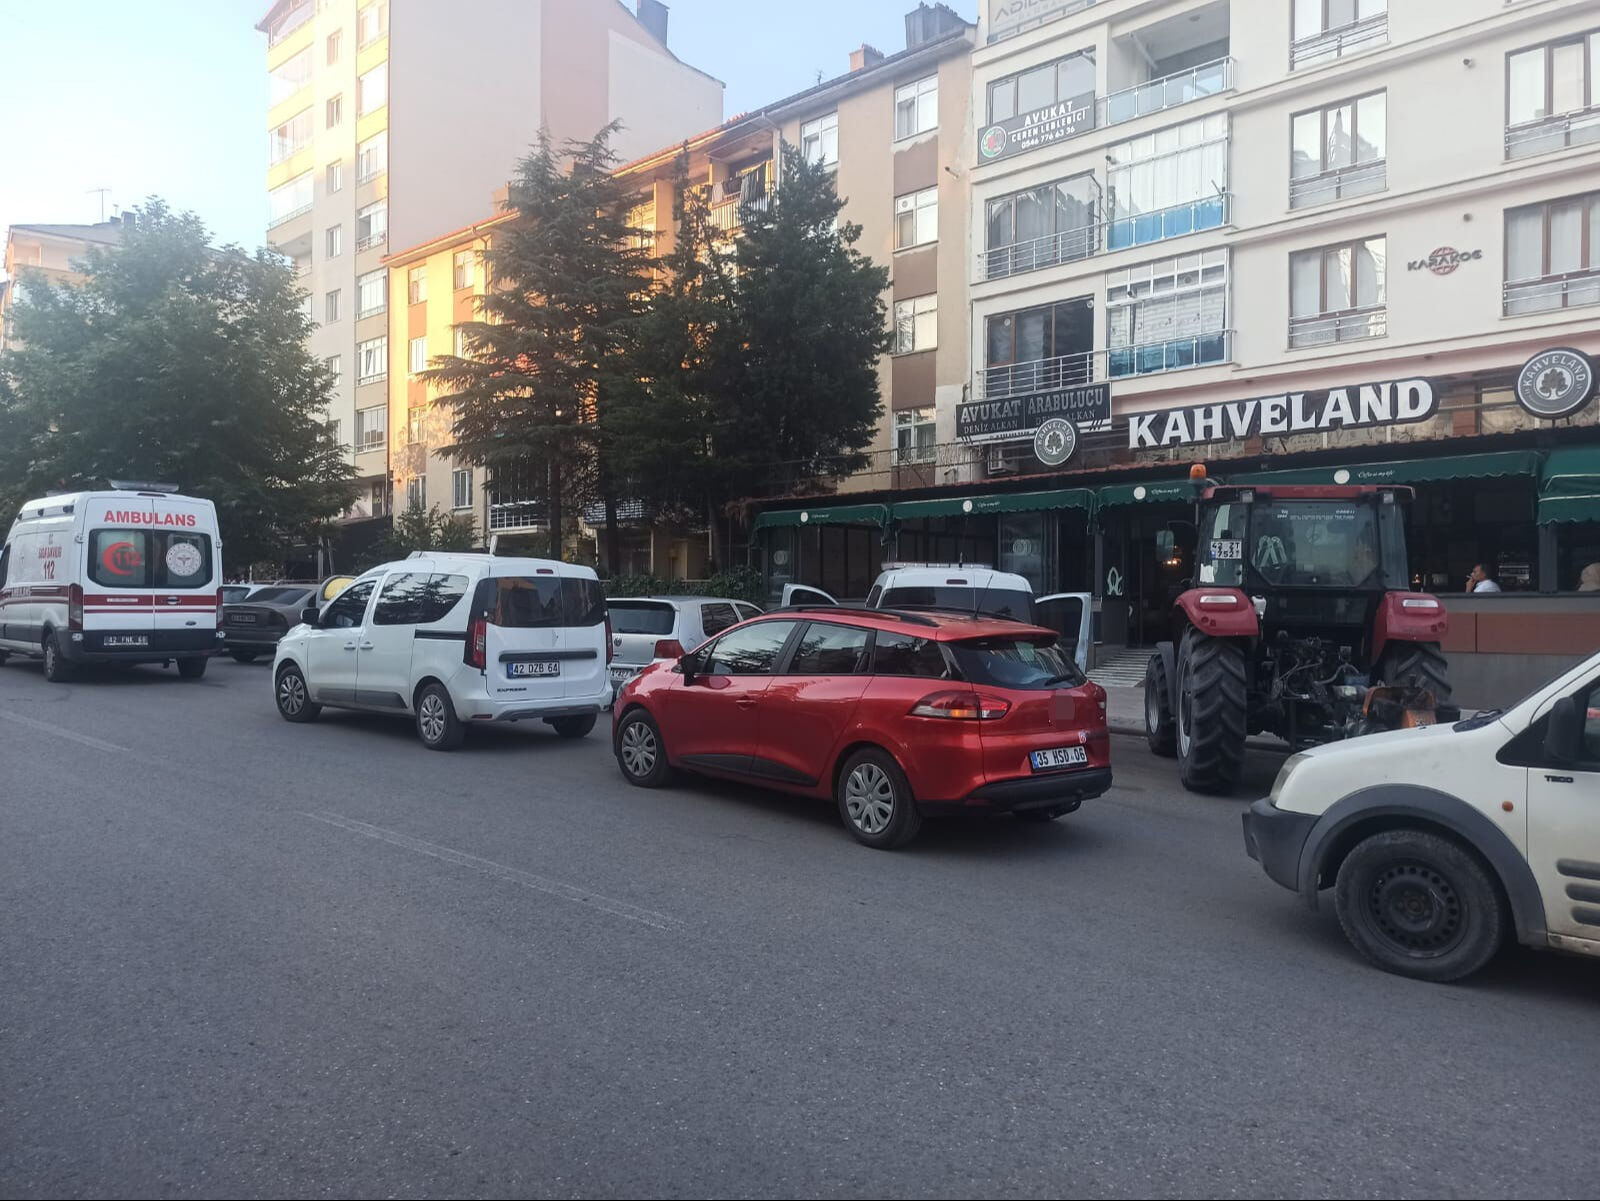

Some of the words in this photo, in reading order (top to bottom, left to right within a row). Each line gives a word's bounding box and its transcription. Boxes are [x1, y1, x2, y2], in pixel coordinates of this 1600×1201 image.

[1024, 101, 1073, 127] AVUKAT
[1011, 126, 1039, 143] CEREN
[1523, 355, 1586, 387] KAHVELAND
[1028, 387, 1103, 415] ARABULUCU
[960, 399, 1021, 424] AVUKAT
[1128, 378, 1434, 450] KAHVELAND
[104, 510, 196, 527] AMBULANS
[115, 551, 142, 567] 112
[44, 560, 55, 580] 112
[513, 664, 525, 674] 42
[529, 663, 544, 673] DZB
[548, 663, 558, 672] 64
[1037, 752, 1049, 766] 35
[1052, 749, 1070, 764] HSD
[1074, 748, 1086, 761] 06
